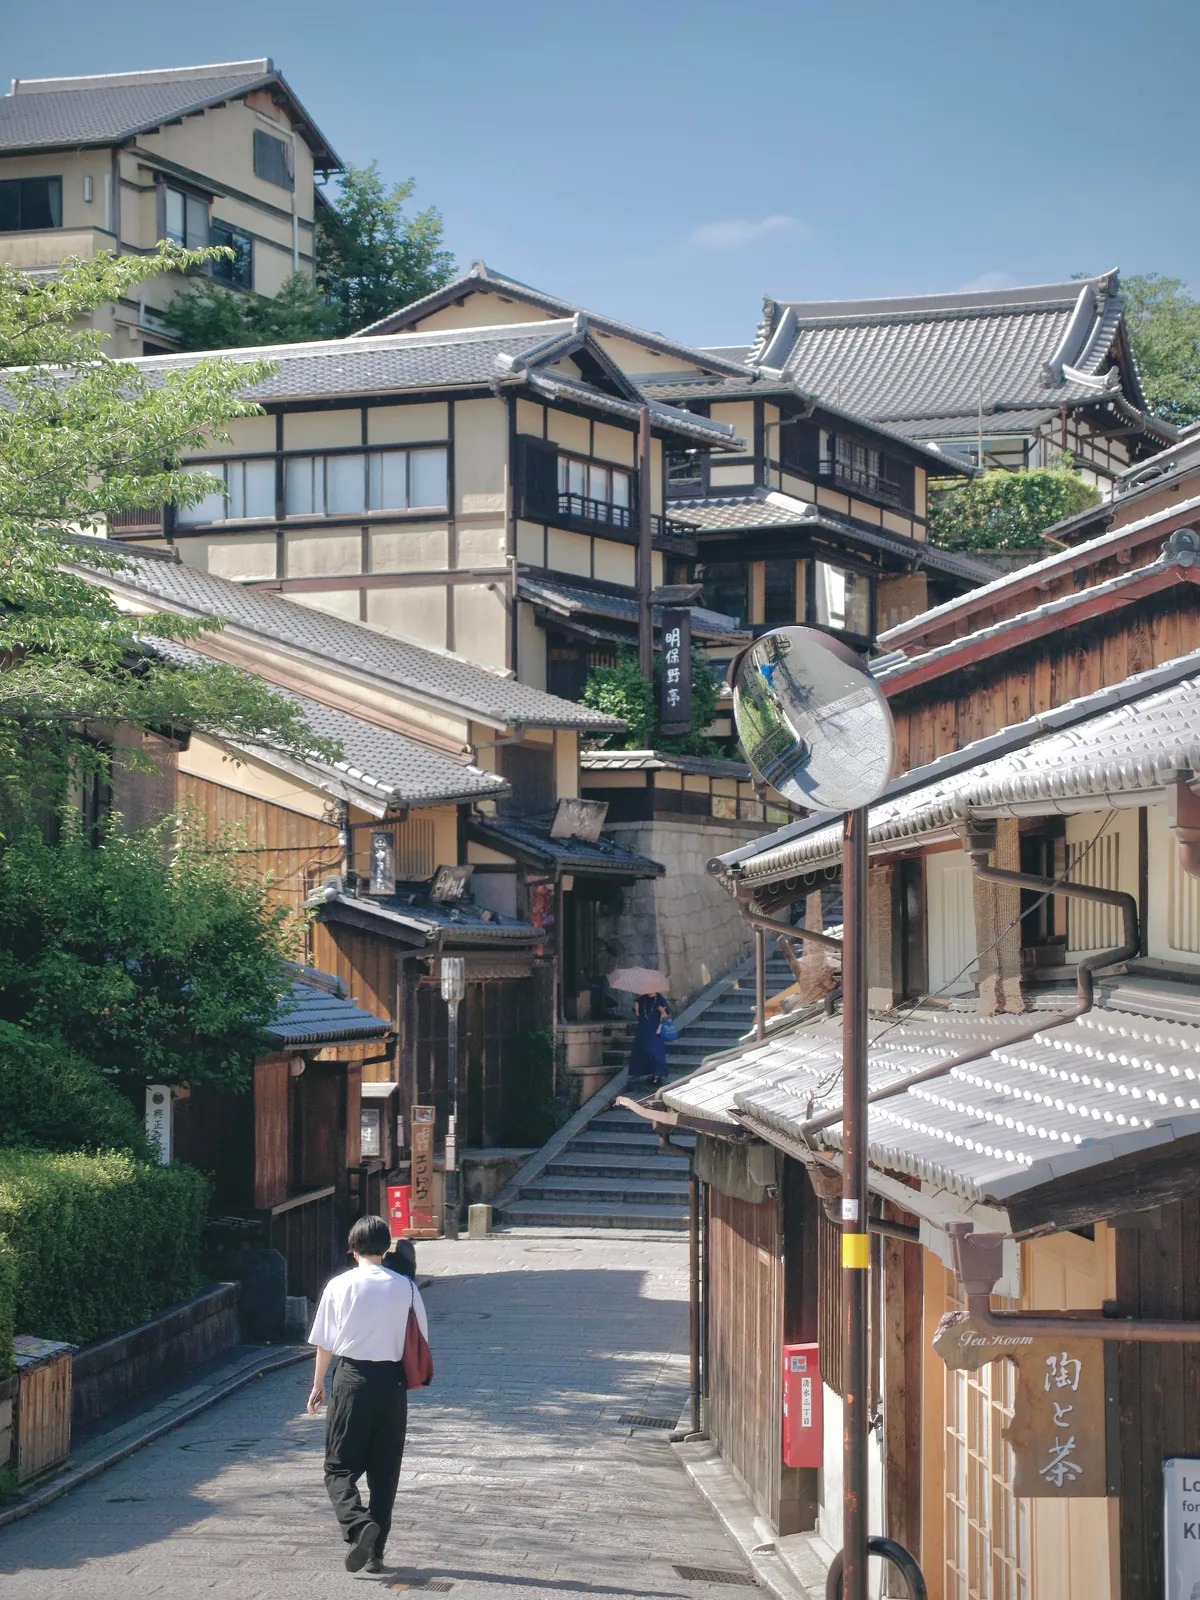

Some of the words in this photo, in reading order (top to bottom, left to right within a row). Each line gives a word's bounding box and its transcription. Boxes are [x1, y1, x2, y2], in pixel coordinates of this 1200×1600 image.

[665, 627, 681, 707] 明保野亭
[416, 1154, 429, 1200] エンドウ
[958, 1330, 987, 1346] Tea
[1038, 1351, 1084, 1488] 陶と茶
